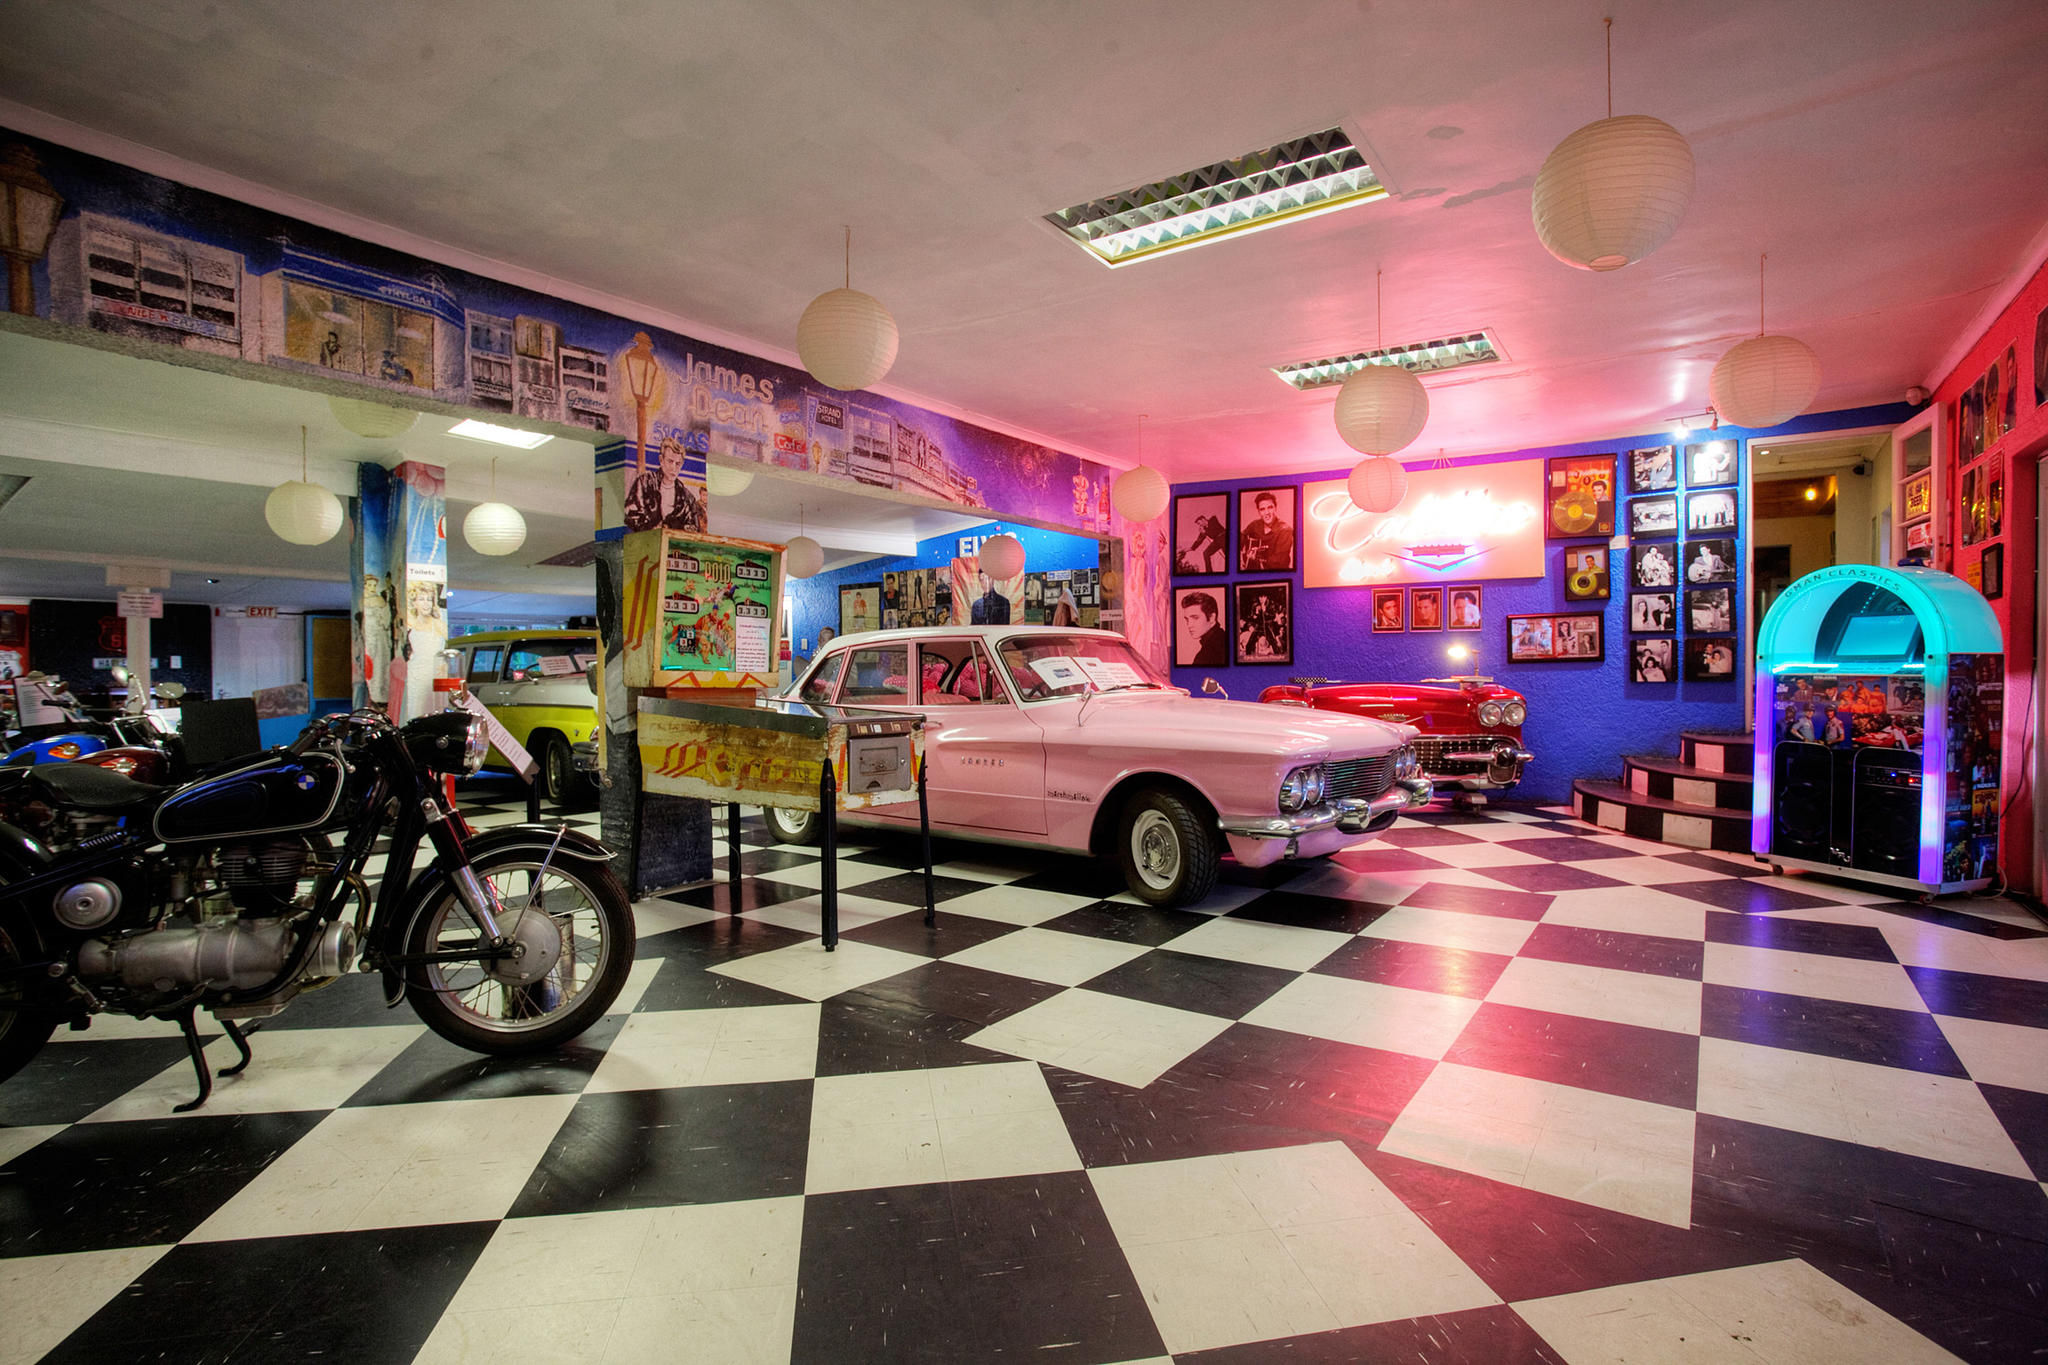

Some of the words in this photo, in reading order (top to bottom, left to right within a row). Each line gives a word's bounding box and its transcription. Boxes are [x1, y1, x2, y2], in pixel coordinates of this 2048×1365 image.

[679, 351, 774, 404] James
[691, 384, 768, 431] Dean
[817, 404, 841, 419] STRAND
[671, 427, 709, 452] GAS
[409, 567, 436, 576] Toilets
[704, 561, 731, 584] POLO
[1828, 568, 1900, 591] CLASSICS
[249, 607, 274, 617] EXIT
